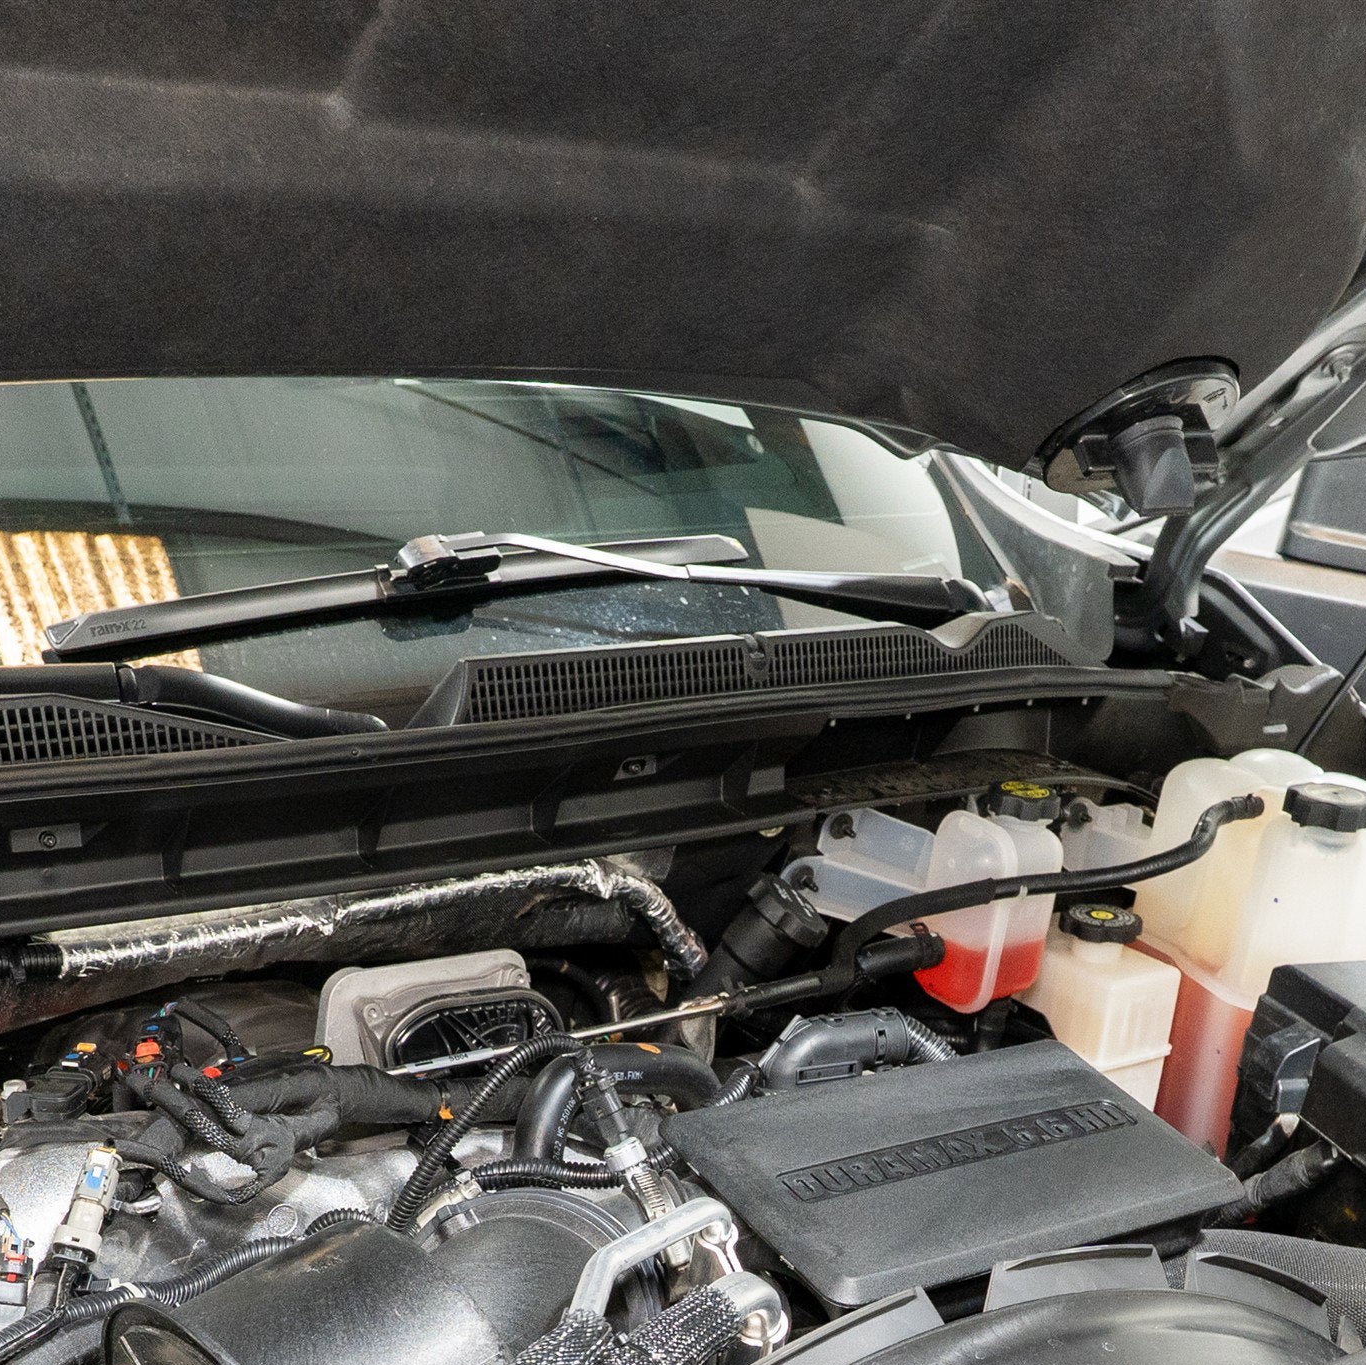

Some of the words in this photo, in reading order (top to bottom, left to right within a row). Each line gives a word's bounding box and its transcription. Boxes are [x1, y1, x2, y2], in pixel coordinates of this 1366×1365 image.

[132, 619, 147, 631] 22
[782, 1131, 1005, 1201] DURAMAX
[1002, 1116, 1075, 1147] 6.6
